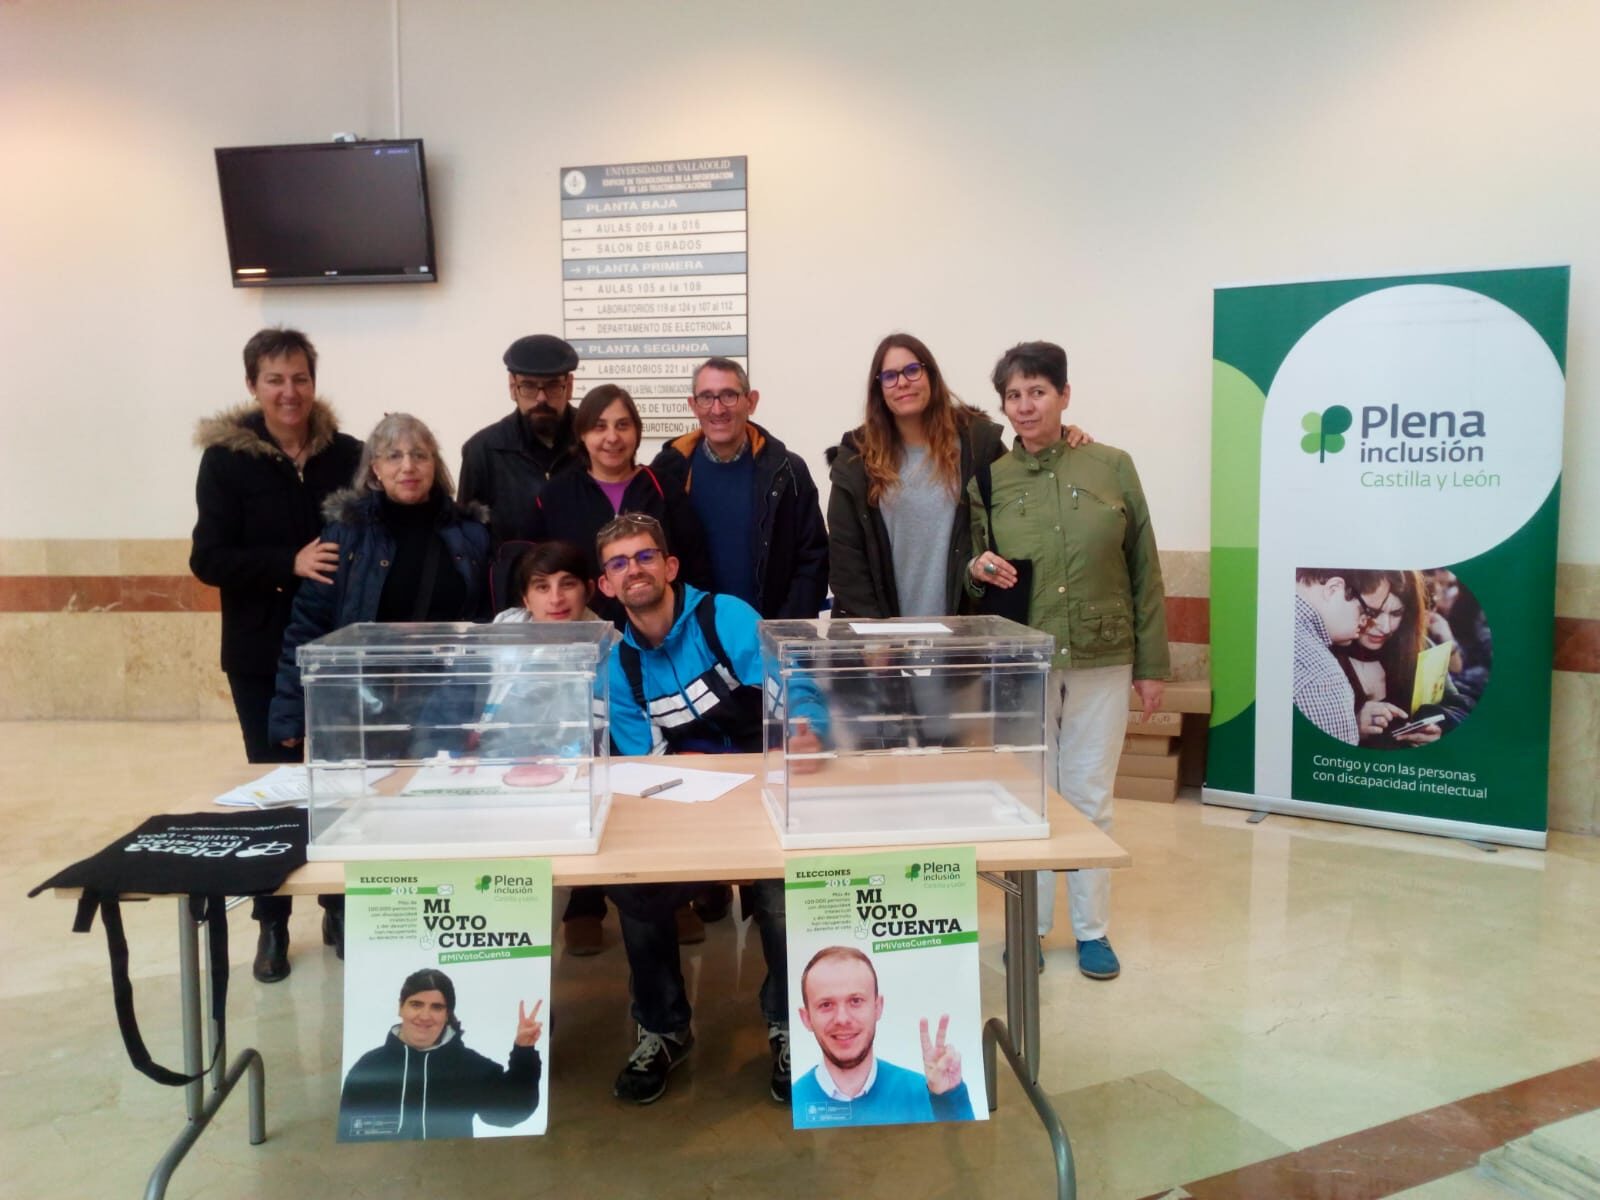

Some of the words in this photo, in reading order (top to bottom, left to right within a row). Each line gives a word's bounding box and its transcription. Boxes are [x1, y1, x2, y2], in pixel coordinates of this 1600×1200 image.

[677, 160, 731, 172] VALLADOLID
[586, 201, 639, 213] PLANTA
[641, 199, 678, 210] BAJA
[596, 222, 632, 233] AULAS
[637, 241, 651, 252] DE
[655, 239, 702, 251] GRADOS
[587, 263, 640, 274] PLANTA
[642, 260, 704, 272] PRIMERA
[597, 283, 633, 294] AULAS
[597, 302, 655, 314] LABORATORIOS
[597, 323, 661, 334] DEPARTAMENTO
[662, 322, 673, 332] DE
[589, 344, 641, 354] PLANTA
[643, 342, 710, 353] SEGUNDA
[598, 363, 663, 375] LABORATORIOS
[648, 403, 660, 413] DE
[1361, 402, 1486, 439] Plena
[1360, 440, 1484, 463] inclusión
[1360, 470, 1431, 488] Castilla
[1435, 474, 1448, 491] y
[1453, 469, 1501, 488] León
[1313, 754, 1362, 772] Contigo
[1363, 762, 1371, 773] y
[1373, 762, 1396, 774] con
[1398, 763, 1416, 776] las
[1418, 767, 1477, 783] personas
[1312, 771, 1335, 782] con
[1337, 771, 1417, 791] discapacidad
[1419, 781, 1488, 799] intelectual
[124, 843, 235, 858] Plena
[796, 869, 851, 879] ELECCIONES
[923, 862, 960, 873] Plena
[360, 876, 418, 884] ELECCIONES
[494, 874, 533, 887] Plena
[923, 872, 960, 881] inclusión
[494, 885, 533, 894] inclusión
[856, 888, 882, 905] MI
[423, 898, 451, 914] MI
[856, 903, 917, 921] VOTO
[423, 915, 486, 932] VOTO
[872, 918, 962, 937] CUENTA
[438, 932, 533, 948] CUENTA
[874, 937, 942, 951] #MiVotoCuenta
[440, 951, 511, 962] #MiVotoCuenta
